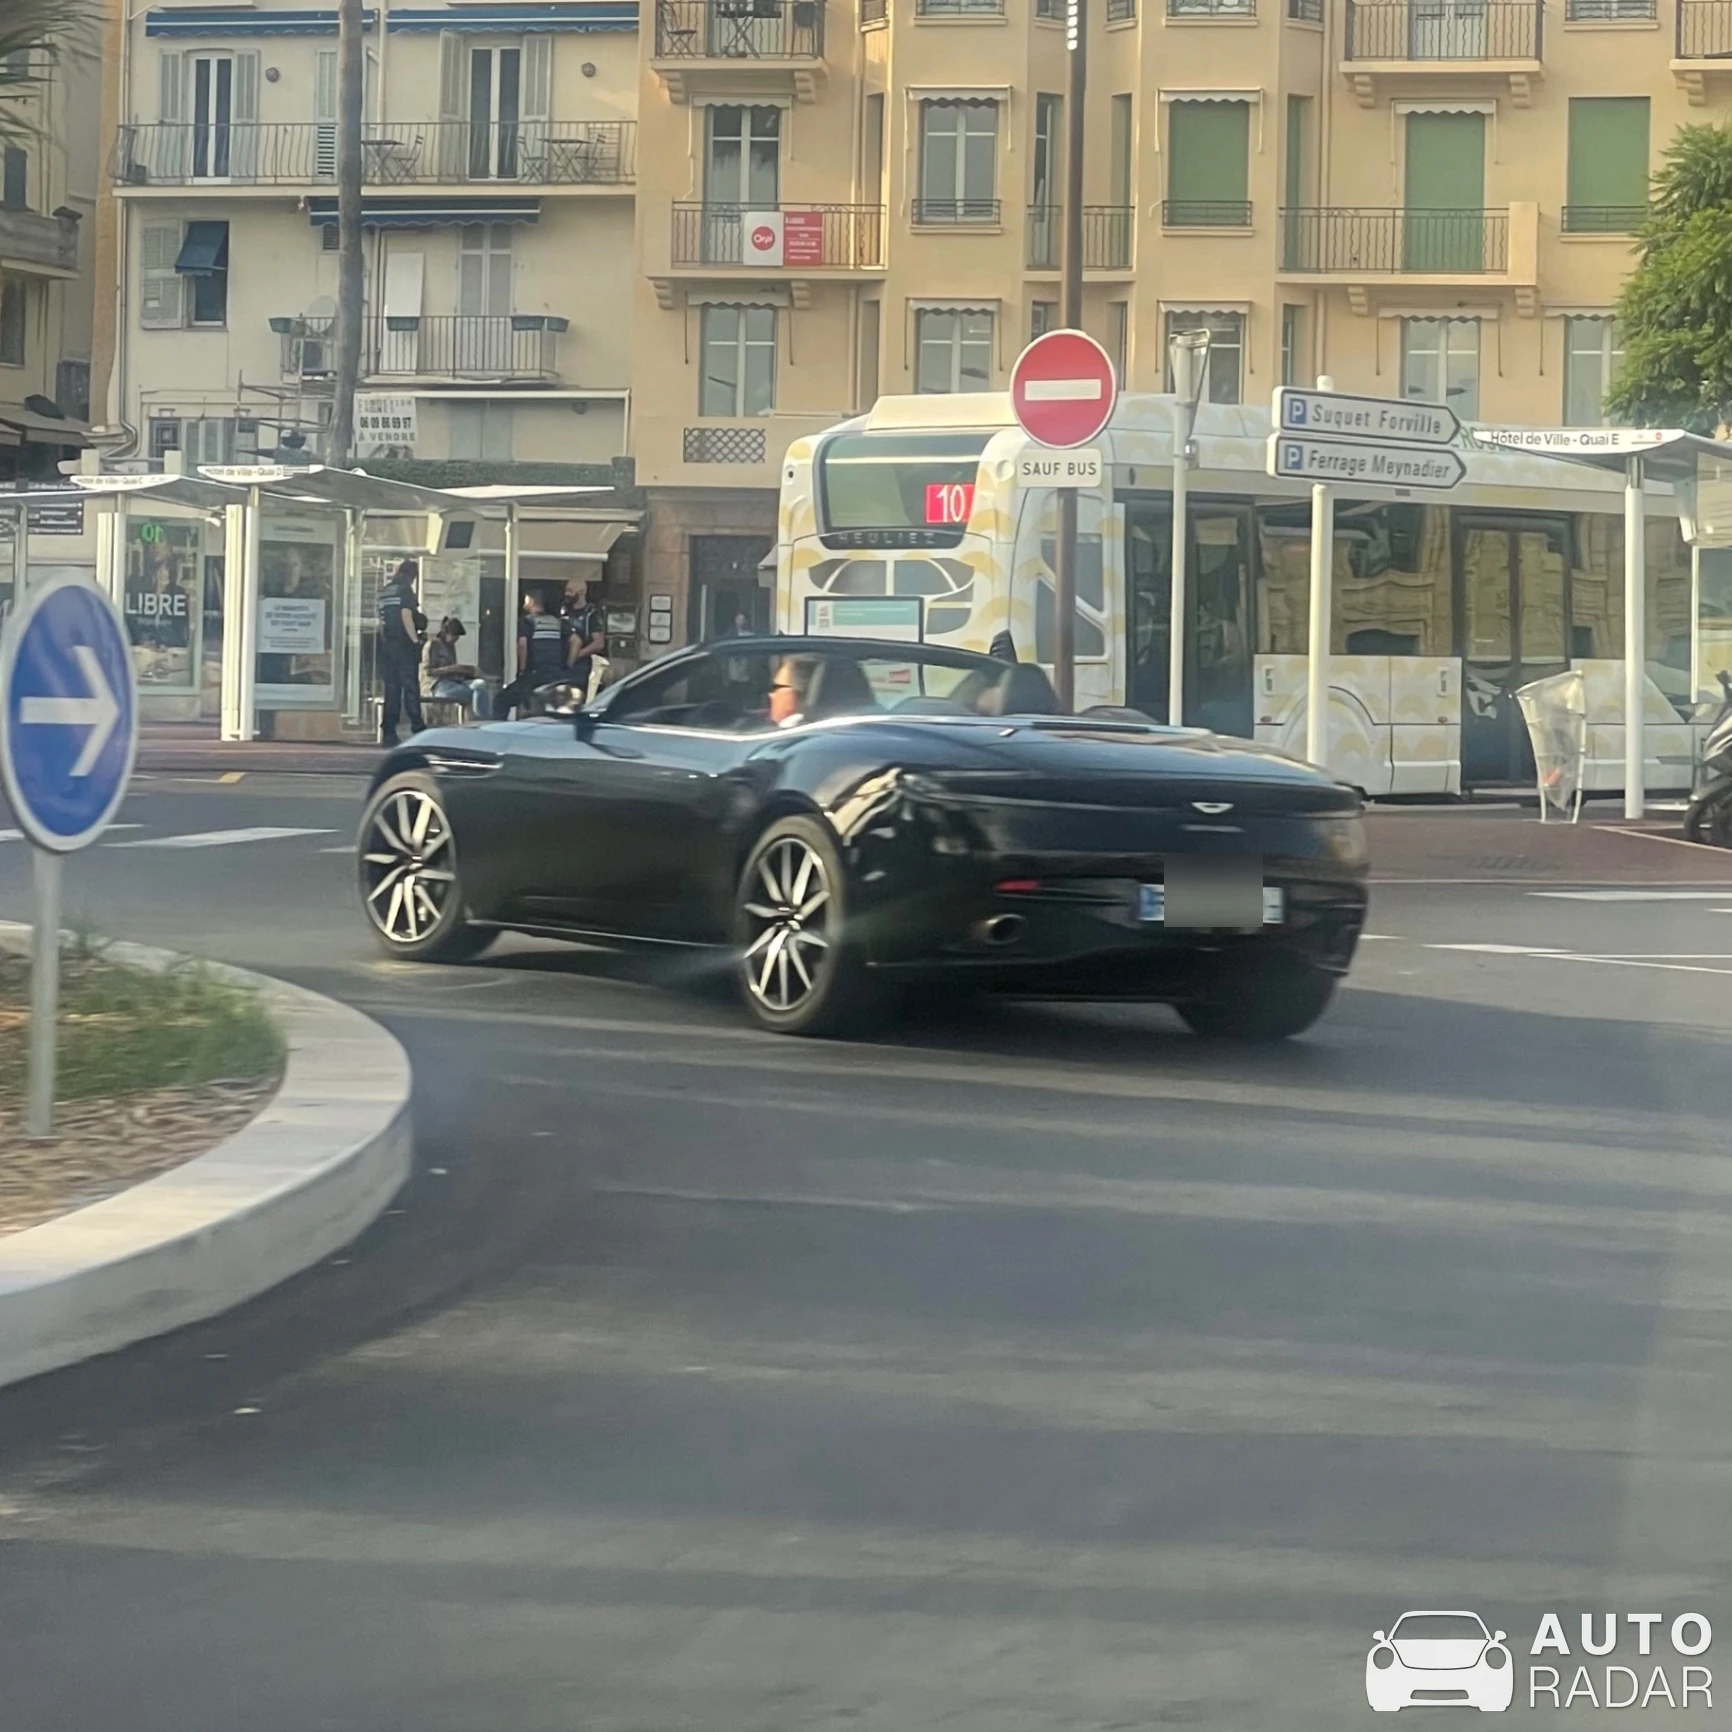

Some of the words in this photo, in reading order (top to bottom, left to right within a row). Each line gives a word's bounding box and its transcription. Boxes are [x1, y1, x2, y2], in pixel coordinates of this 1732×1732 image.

[753, 233, 774, 245] Orpi
[1291, 401, 1304, 421] P
[1312, 404, 1370, 428] Suquet
[1379, 410, 1441, 433] Forville
[370, 432, 415, 441] VENDRE
[1491, 431, 1522, 445] Hôtel
[1526, 433, 1540, 444] de
[1543, 433, 1570, 446] Ville
[1580, 434, 1608, 446] Quai
[1612, 434, 1619, 445] E
[1288, 448, 1300, 468] P
[1309, 451, 1366, 475] Ferrage
[1372, 456, 1450, 479] Meynadier
[1023, 462, 1061, 475] SAUF
[1068, 462, 1096, 475] BUS
[936, 484, 965, 522] 10
[125, 593, 186, 616] LIBRE
